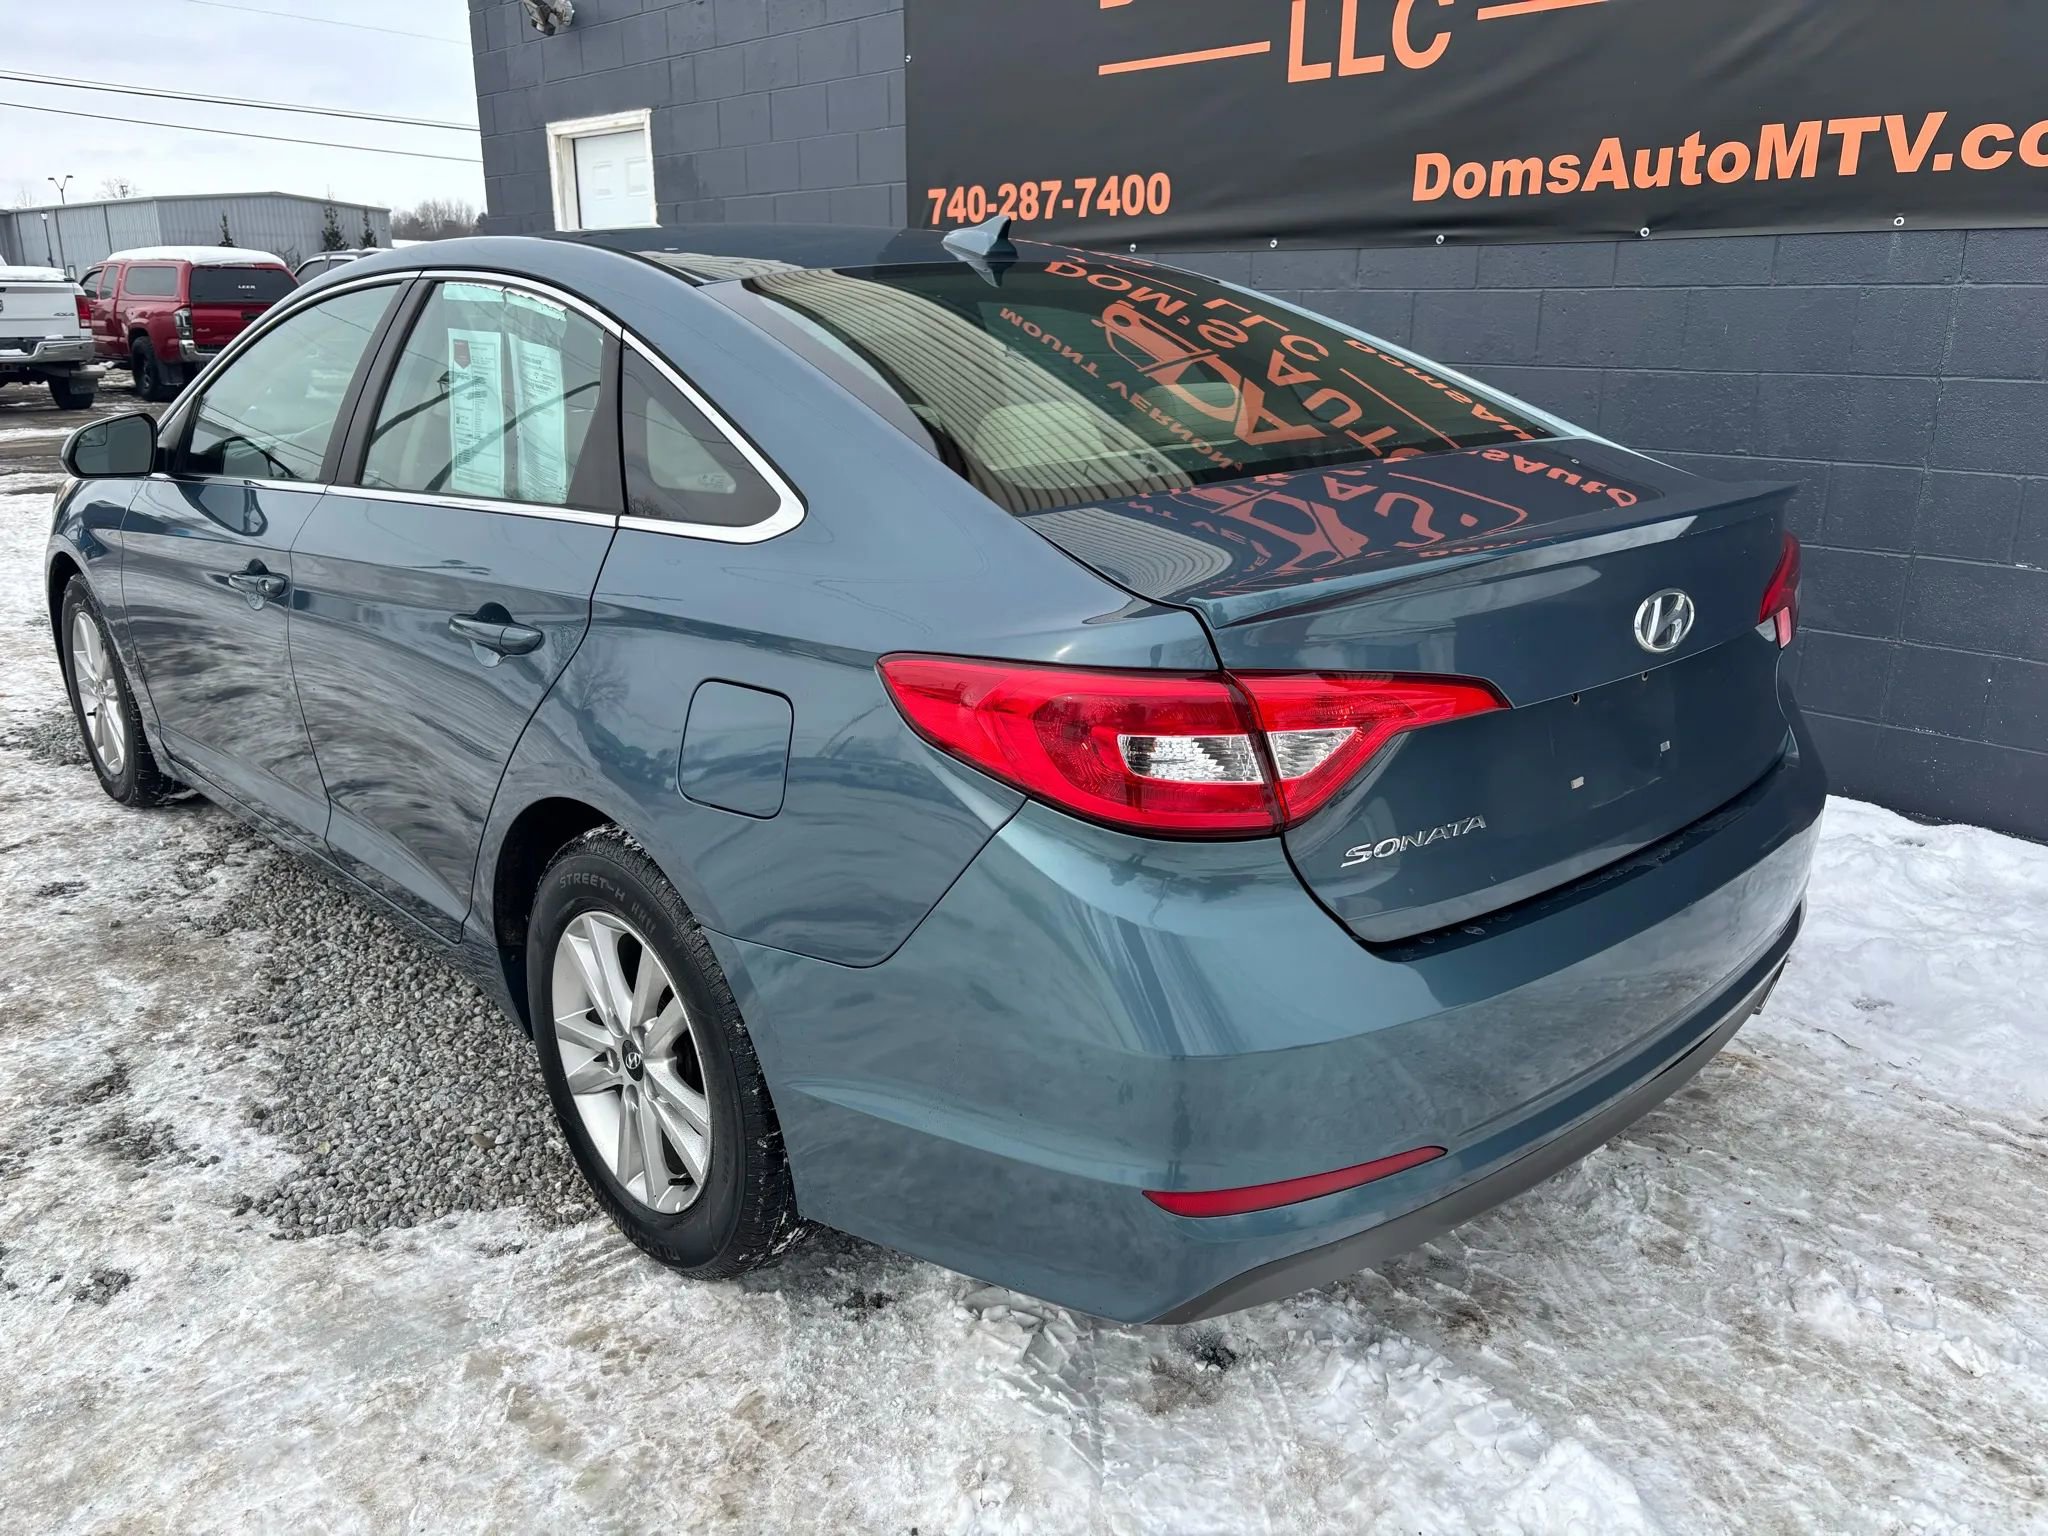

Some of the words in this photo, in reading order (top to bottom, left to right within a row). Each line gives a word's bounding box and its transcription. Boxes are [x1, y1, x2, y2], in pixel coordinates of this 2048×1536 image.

[1288, 0, 1455, 83] LLC
[927, 172, 1171, 225] 740-287-7400
[1340, 814, 1487, 868] SONATA
